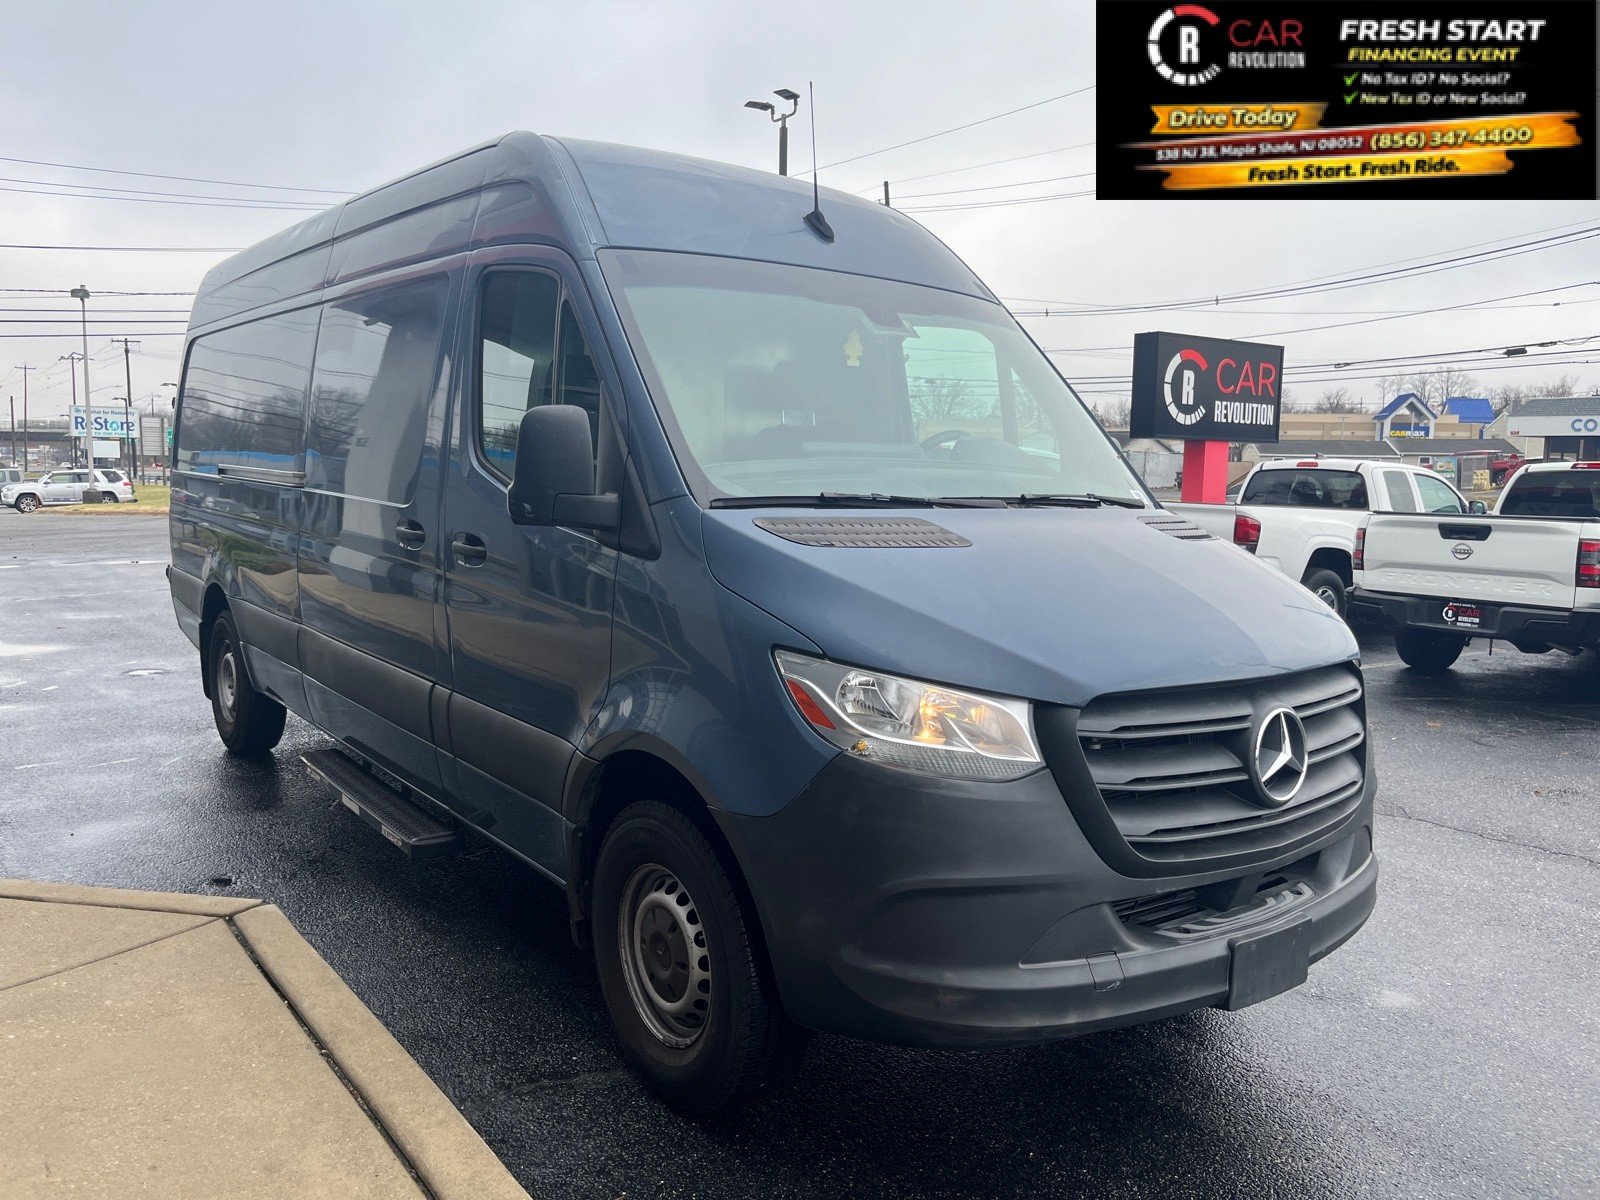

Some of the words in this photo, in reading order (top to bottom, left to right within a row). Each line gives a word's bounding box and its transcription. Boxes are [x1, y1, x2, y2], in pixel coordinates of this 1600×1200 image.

[1181, 369, 1196, 406] R
[1216, 358, 1277, 398] CAR
[74, 416, 136, 432] RStore
[1213, 400, 1275, 426] REVOLUTION
[1571, 418, 1598, 433] CO
[1380, 569, 1553, 596] FRONTIER
[1458, 607, 1481, 618] CAR
